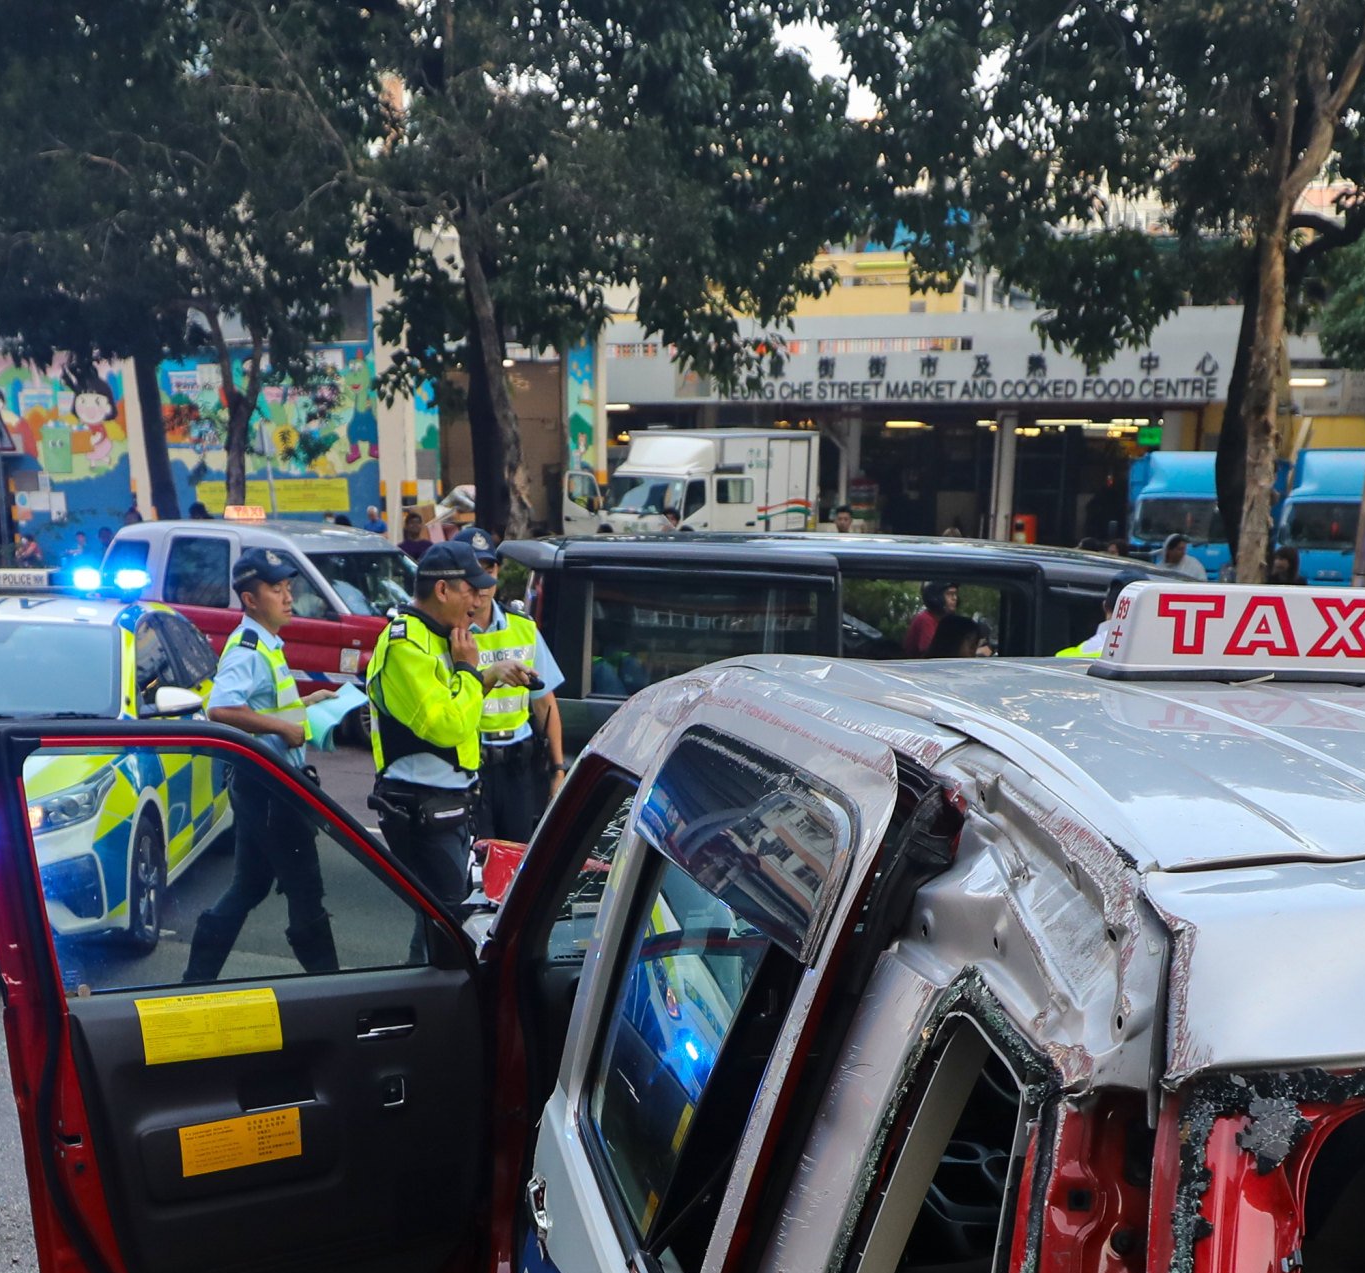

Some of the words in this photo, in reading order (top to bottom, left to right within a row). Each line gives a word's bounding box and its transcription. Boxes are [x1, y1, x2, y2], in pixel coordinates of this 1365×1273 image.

[779, 381, 813, 400] CHE
[817, 381, 883, 400] STREET
[885, 380, 957, 399] MARKET
[960, 379, 998, 399] AND
[1000, 379, 1078, 399] COOKED
[1082, 378, 1135, 399] FOOD
[1139, 377, 1218, 399] CENTRE
[2, 573, 32, 585] POLICE
[1108, 596, 1132, 649] 的士
